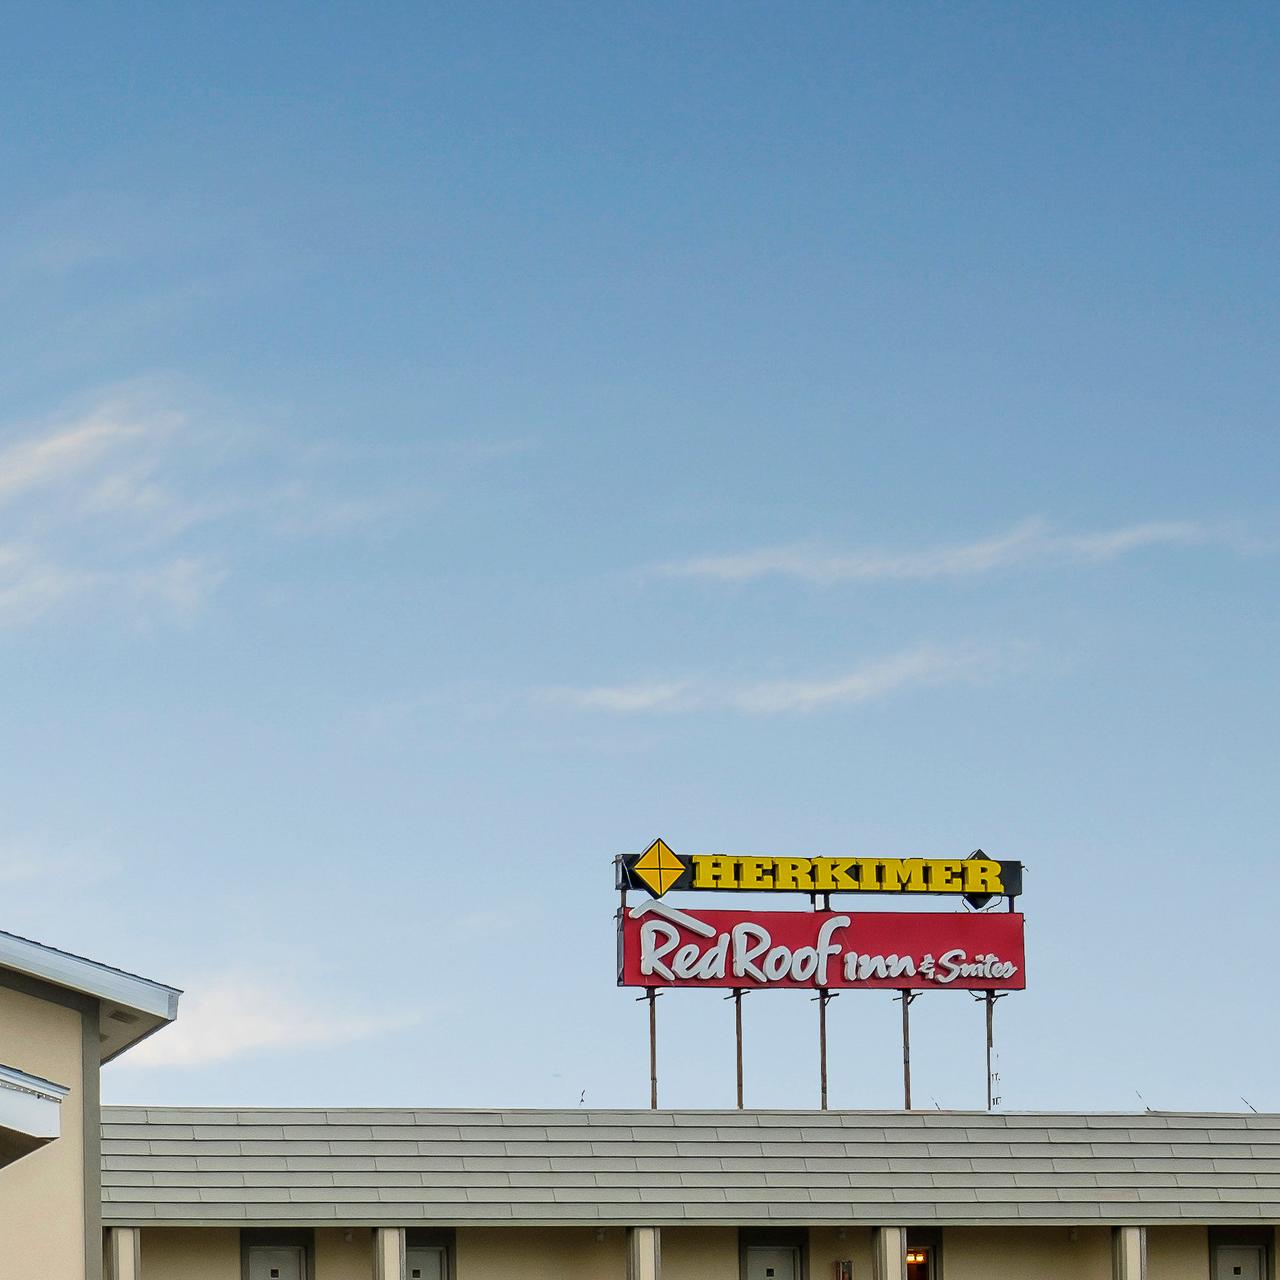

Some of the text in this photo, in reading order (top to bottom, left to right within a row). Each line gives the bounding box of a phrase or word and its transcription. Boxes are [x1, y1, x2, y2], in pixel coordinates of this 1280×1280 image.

[692, 854, 1004, 894] HERKIMER
[640, 919, 730, 981] Red
[732, 915, 851, 985] Roof
[935, 949, 1018, 984] Suites
